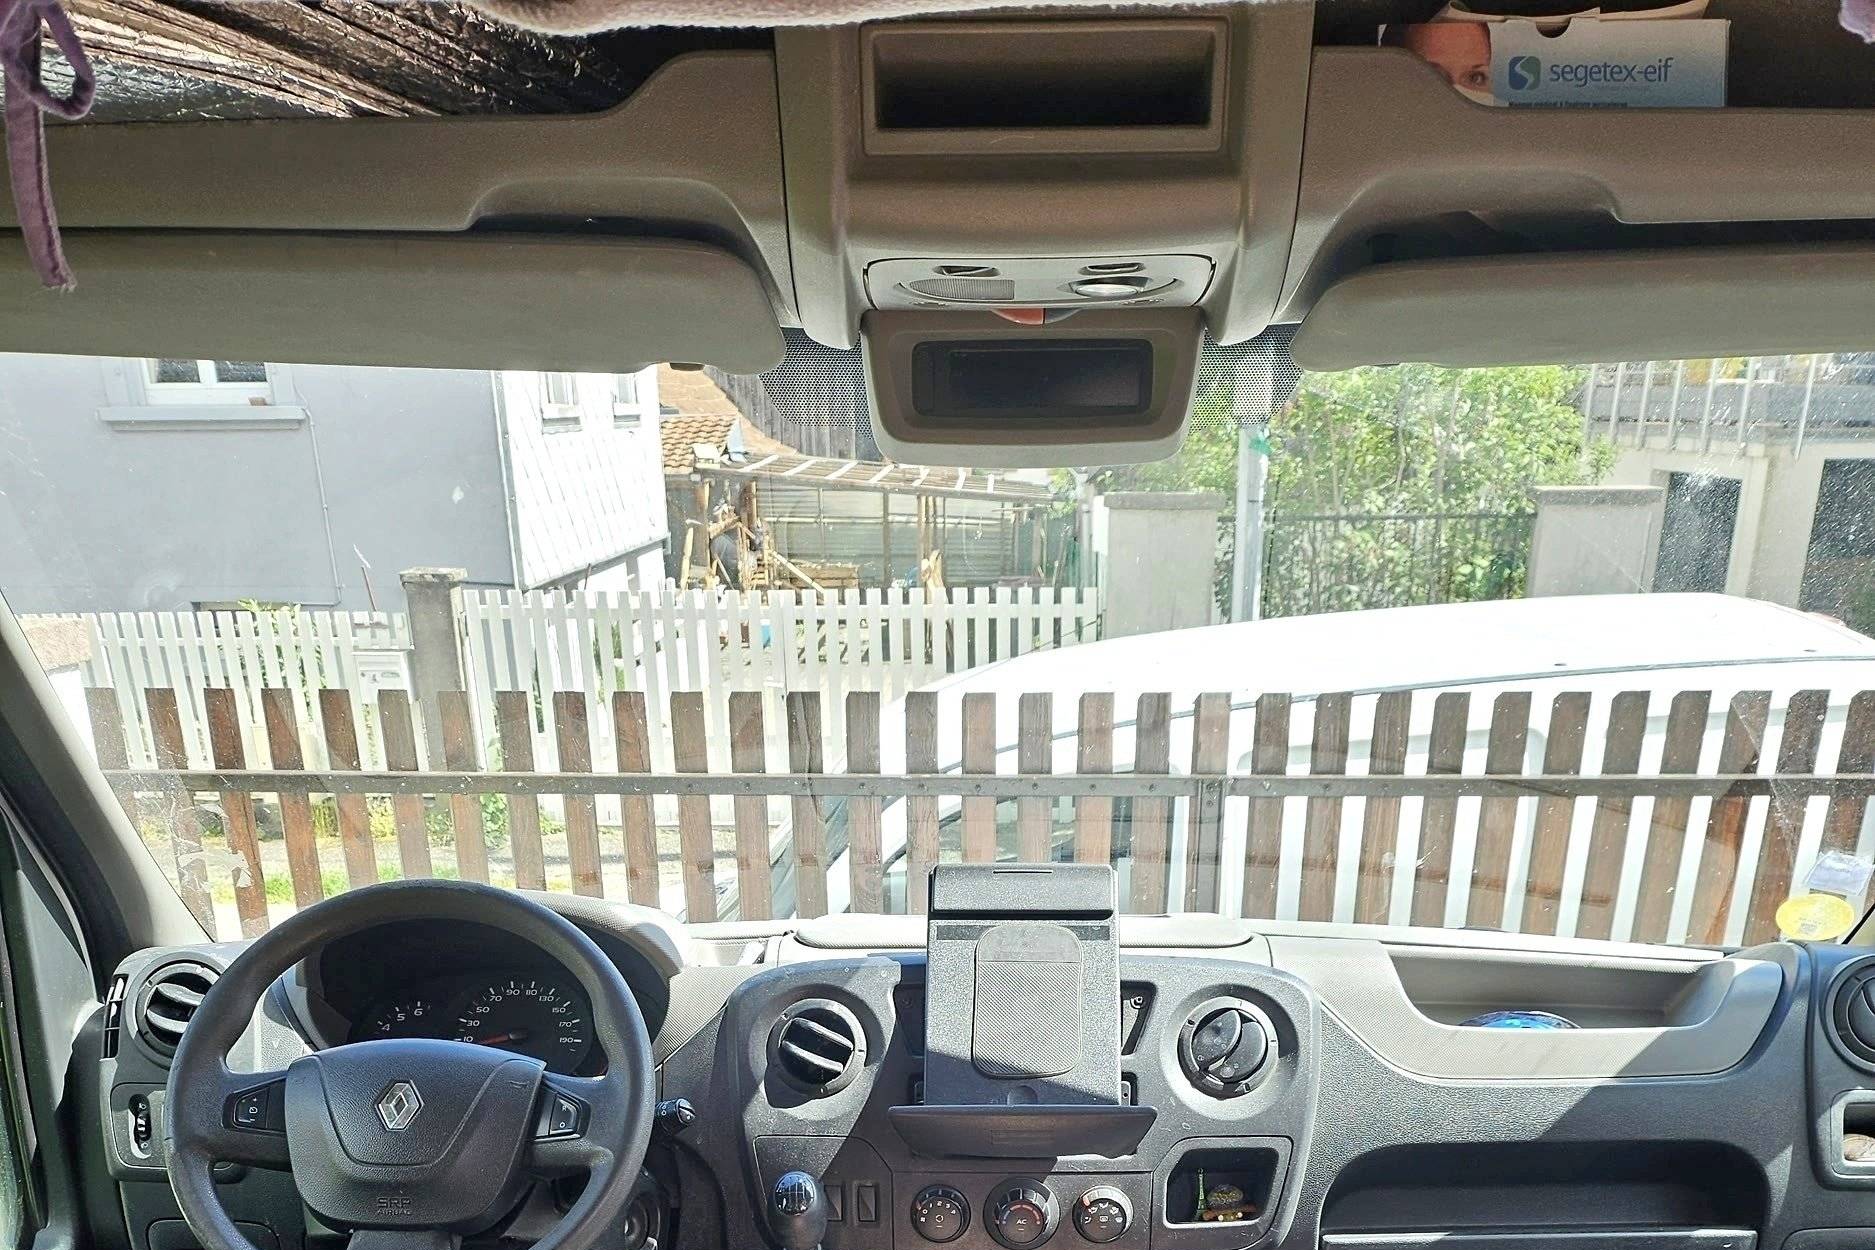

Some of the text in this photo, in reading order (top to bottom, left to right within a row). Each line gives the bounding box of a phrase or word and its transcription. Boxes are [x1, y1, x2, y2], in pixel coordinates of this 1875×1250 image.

[1550, 57, 1674, 88] segetex-eif
[414, 1008, 423, 1016] 6
[396, 1013, 406, 1021] 5
[381, 1023, 390, 1031] 4
[466, 1019, 480, 1027] 30
[463, 1035, 474, 1043] 10
